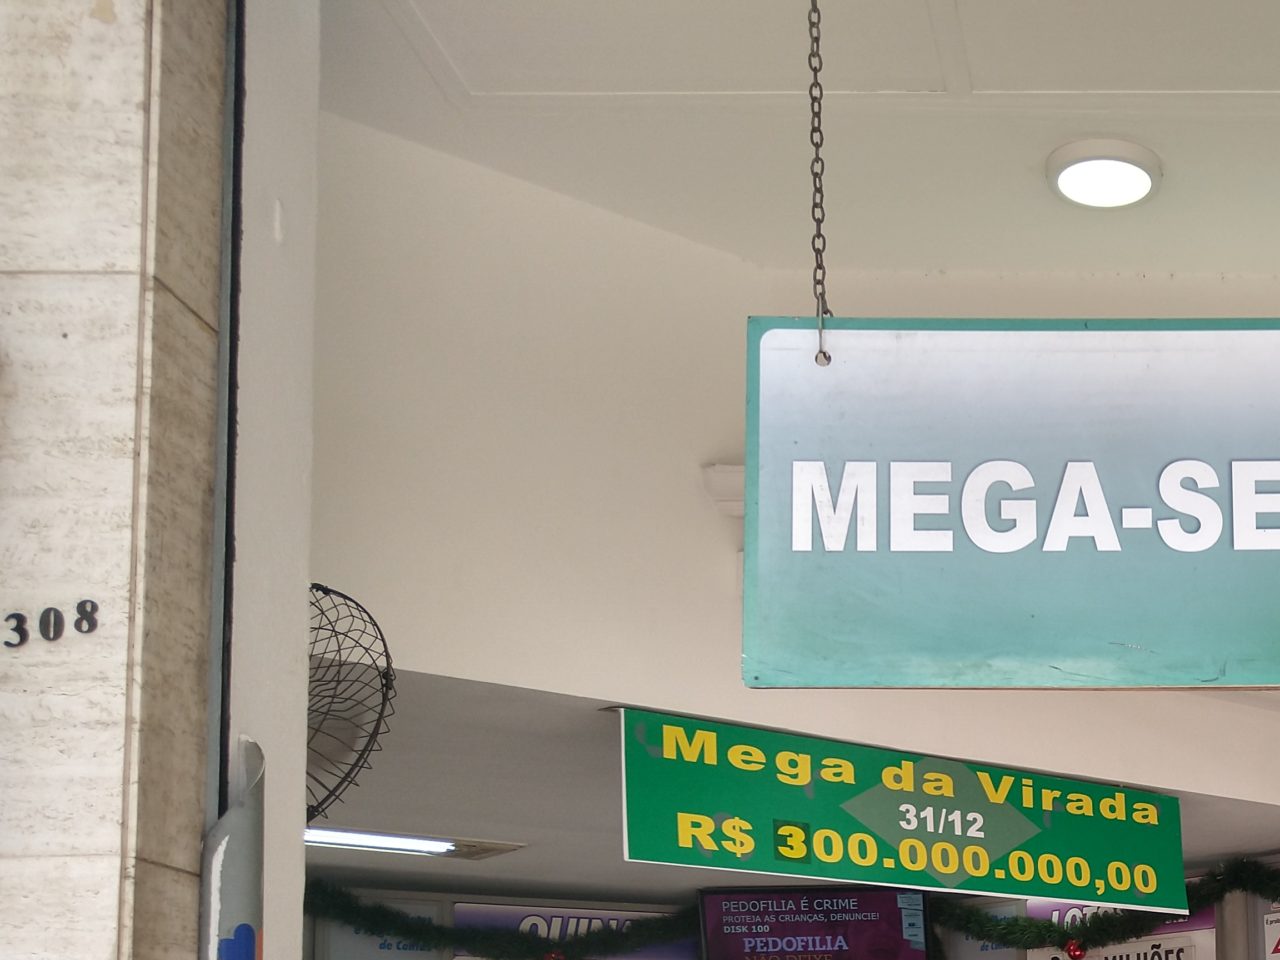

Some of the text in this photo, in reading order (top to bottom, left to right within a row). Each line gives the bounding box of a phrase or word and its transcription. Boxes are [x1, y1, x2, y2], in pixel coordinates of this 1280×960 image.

[4, 600, 99, 648] 308
[662, 724, 1159, 825] Mega da Virada
[898, 804, 985, 838] 31/12
[677, 812, 1158, 894] R$ 300.000.000,00
[722, 896, 859, 912] PEDOFILIA É CRIME
[722, 915, 761, 923] PROTEJA
[764, 914, 776, 922] AS
[830, 912, 880, 921] DENUNCIE!
[723, 925, 770, 934] DISK 100
[743, 936, 849, 952] PEDOFILIA
